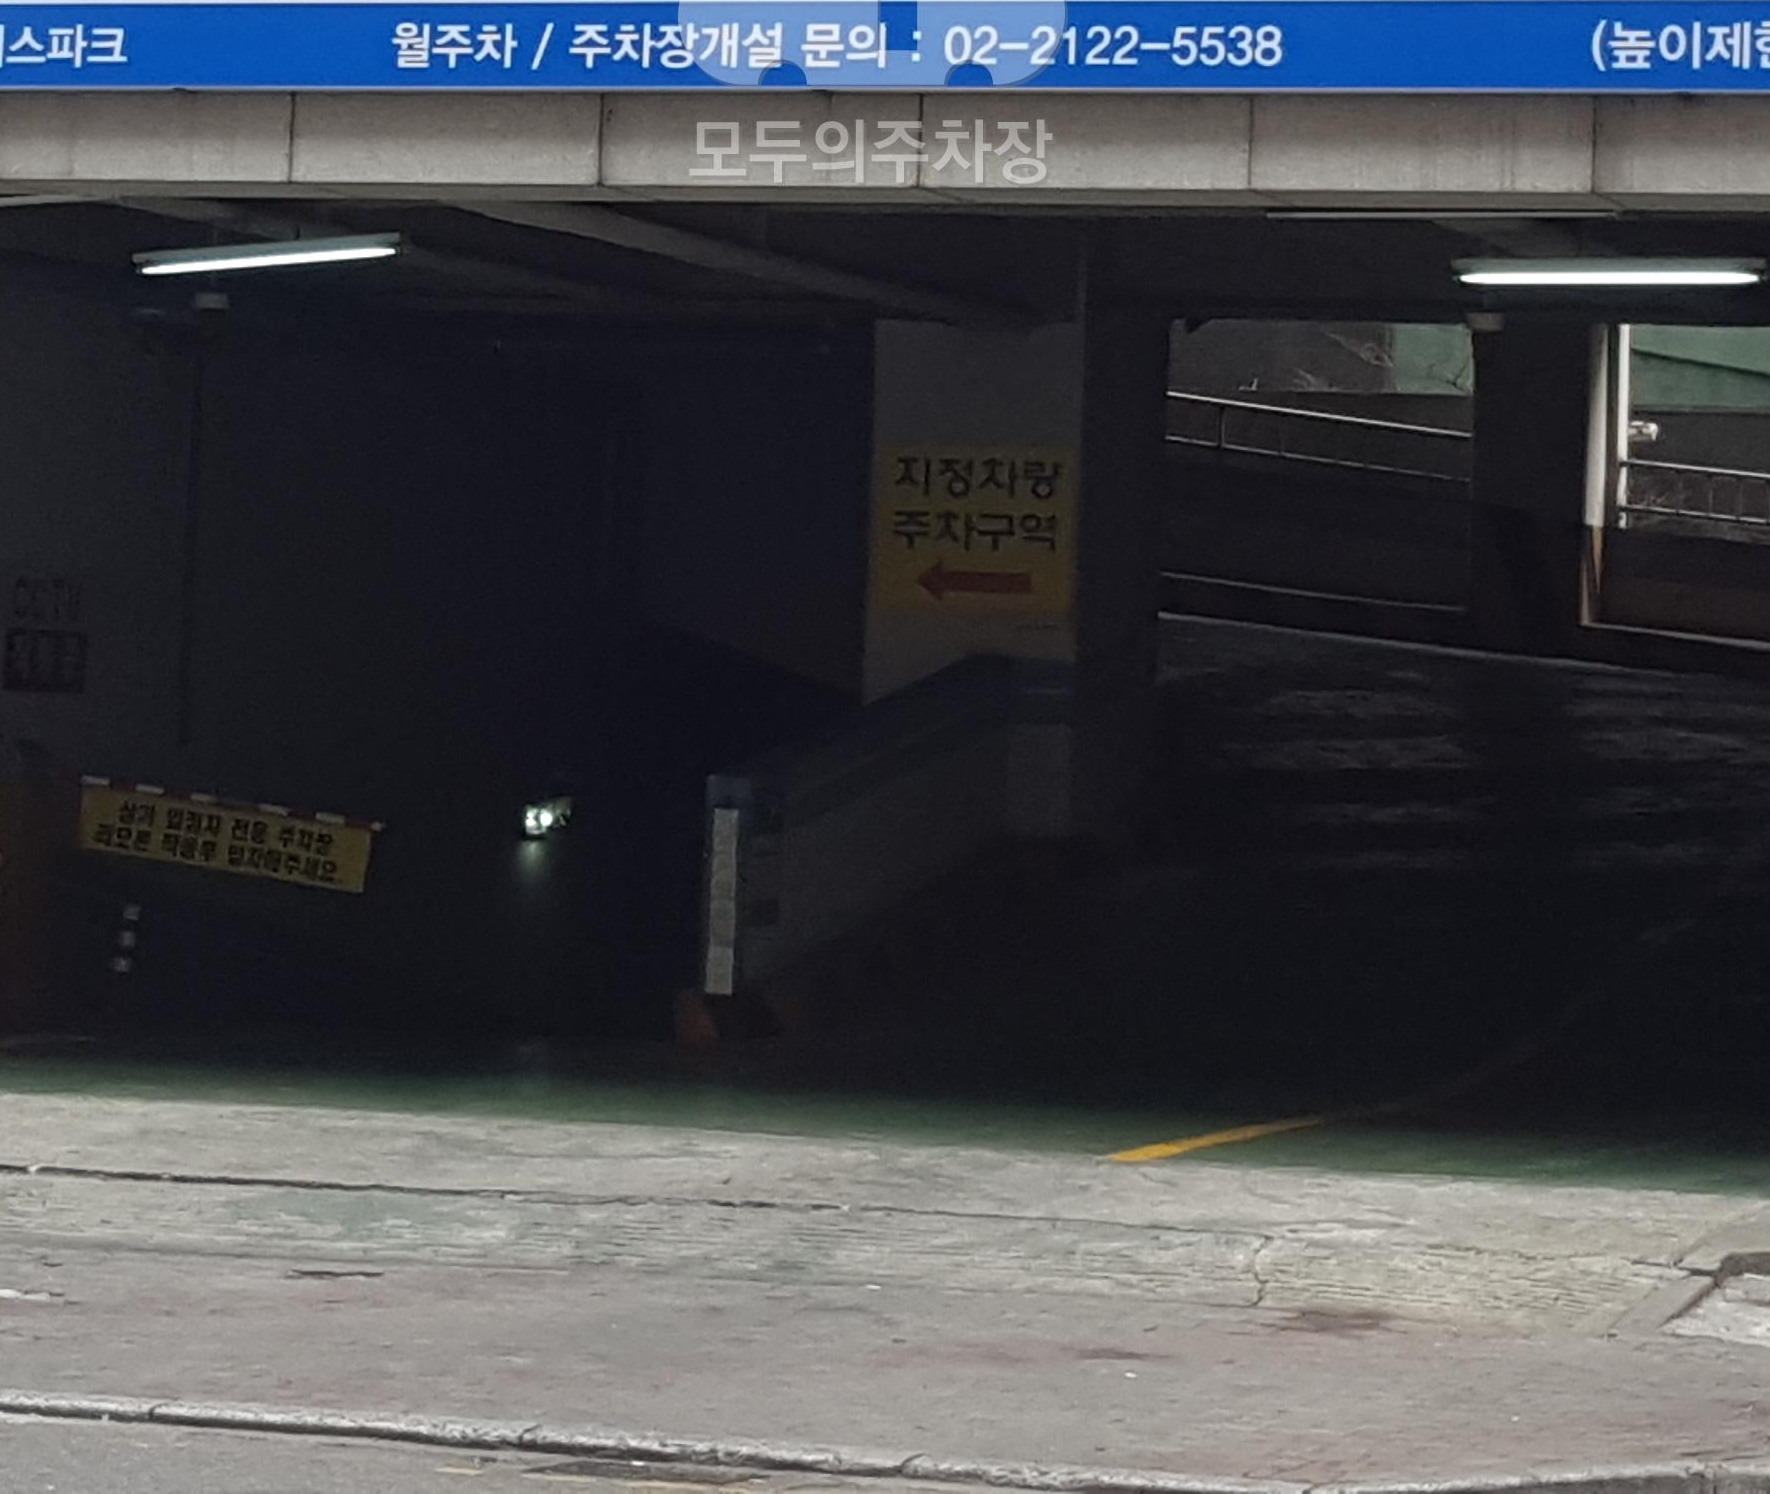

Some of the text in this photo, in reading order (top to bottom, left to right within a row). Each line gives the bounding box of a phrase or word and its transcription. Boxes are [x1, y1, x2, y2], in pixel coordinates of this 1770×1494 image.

[391, 21, 517, 70] 월주차
[568, 21, 784, 70] 주차장개설
[800, 22, 888, 69] 문의
[944, 25, 1282, 66] 02-2122-5538
[895, 458, 1064, 499] 지정차량
[893, 511, 1057, 552] 주차구역
